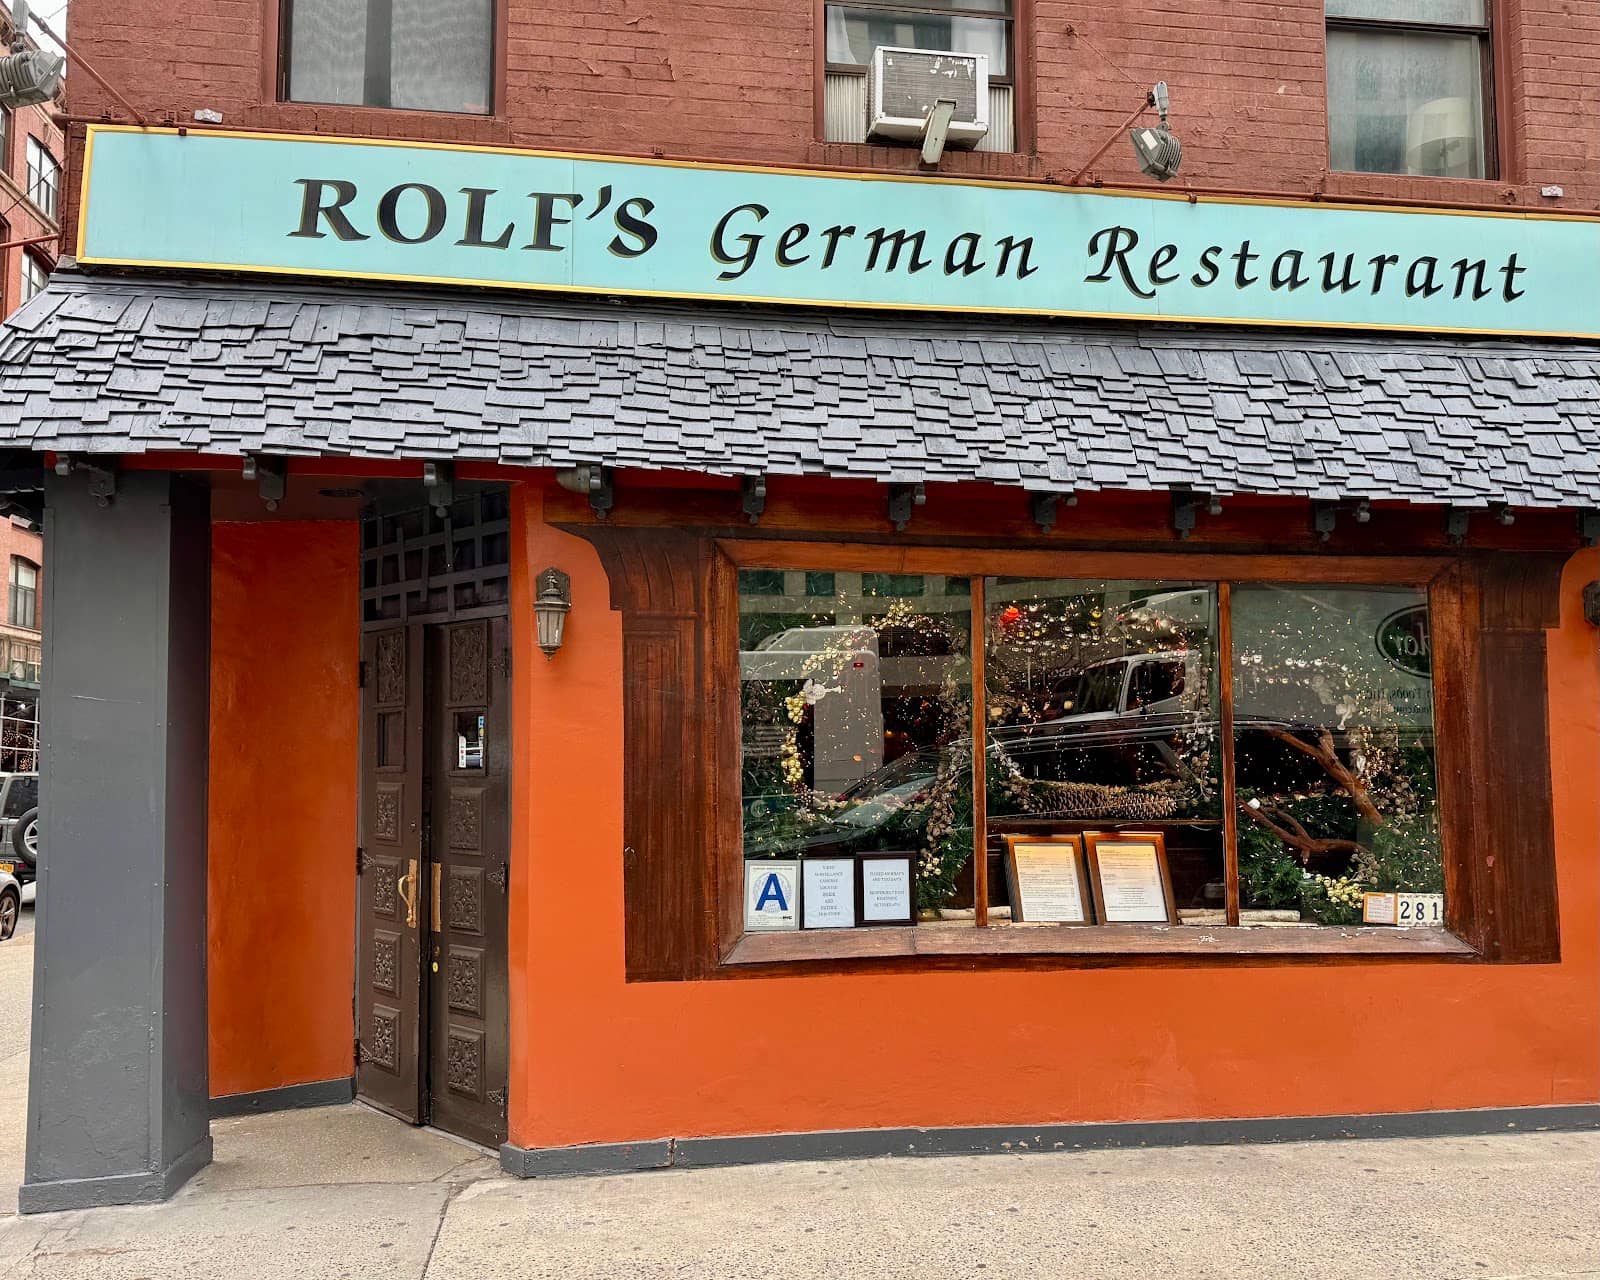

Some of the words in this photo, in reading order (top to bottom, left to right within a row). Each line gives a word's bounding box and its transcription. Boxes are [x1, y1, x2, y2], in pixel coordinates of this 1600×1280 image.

[287, 179, 657, 258] ROLF'S
[710, 204, 1038, 280] German
[1084, 225, 1527, 302] Restaurant
[755, 873, 788, 911] A
[1399, 901, 1439, 921] 281
